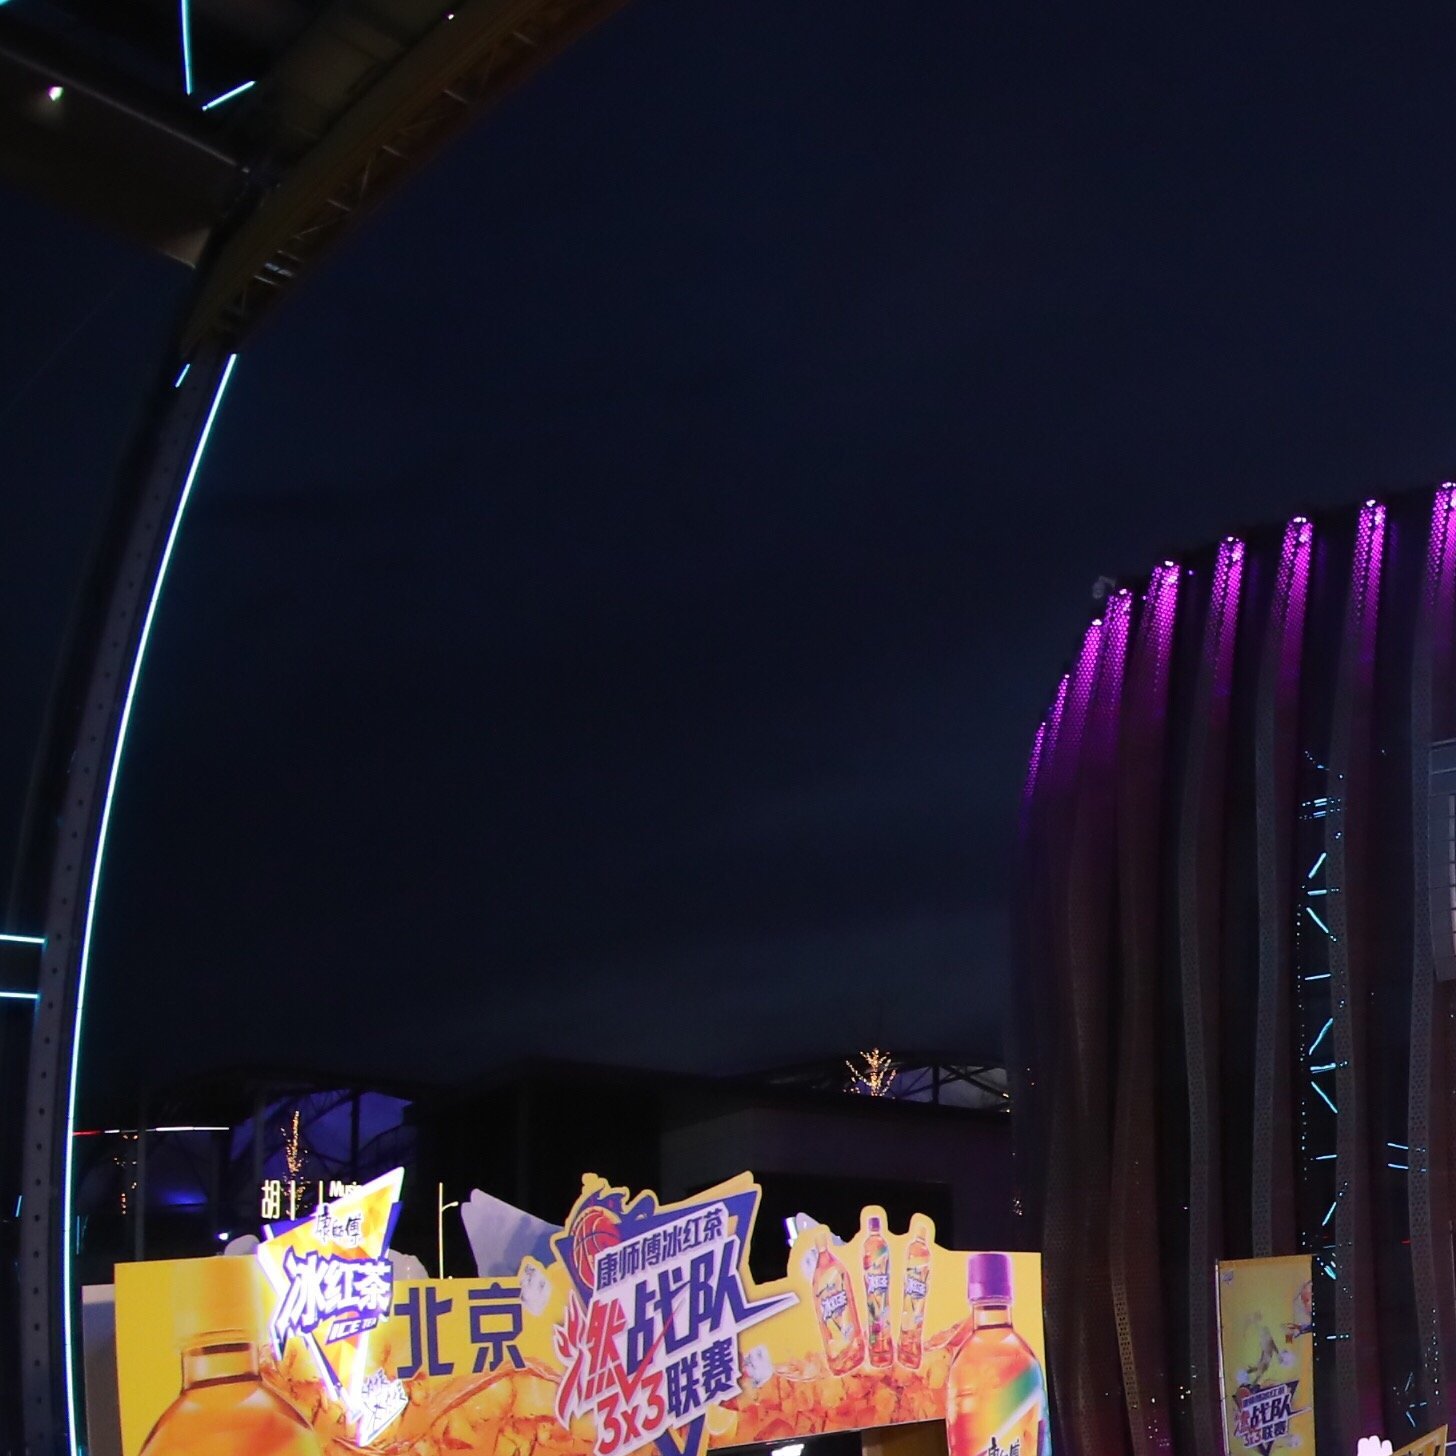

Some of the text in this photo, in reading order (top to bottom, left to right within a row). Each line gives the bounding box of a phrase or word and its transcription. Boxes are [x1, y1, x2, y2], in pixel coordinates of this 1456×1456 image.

[596, 1208, 723, 1291] 康师傅冰红茶
[274, 1250, 392, 1342] 冰红茶
[330, 1317, 360, 1340] ICE
[394, 1282, 526, 1379] 北京
[597, 1337, 734, 1455] 3x3联赛
